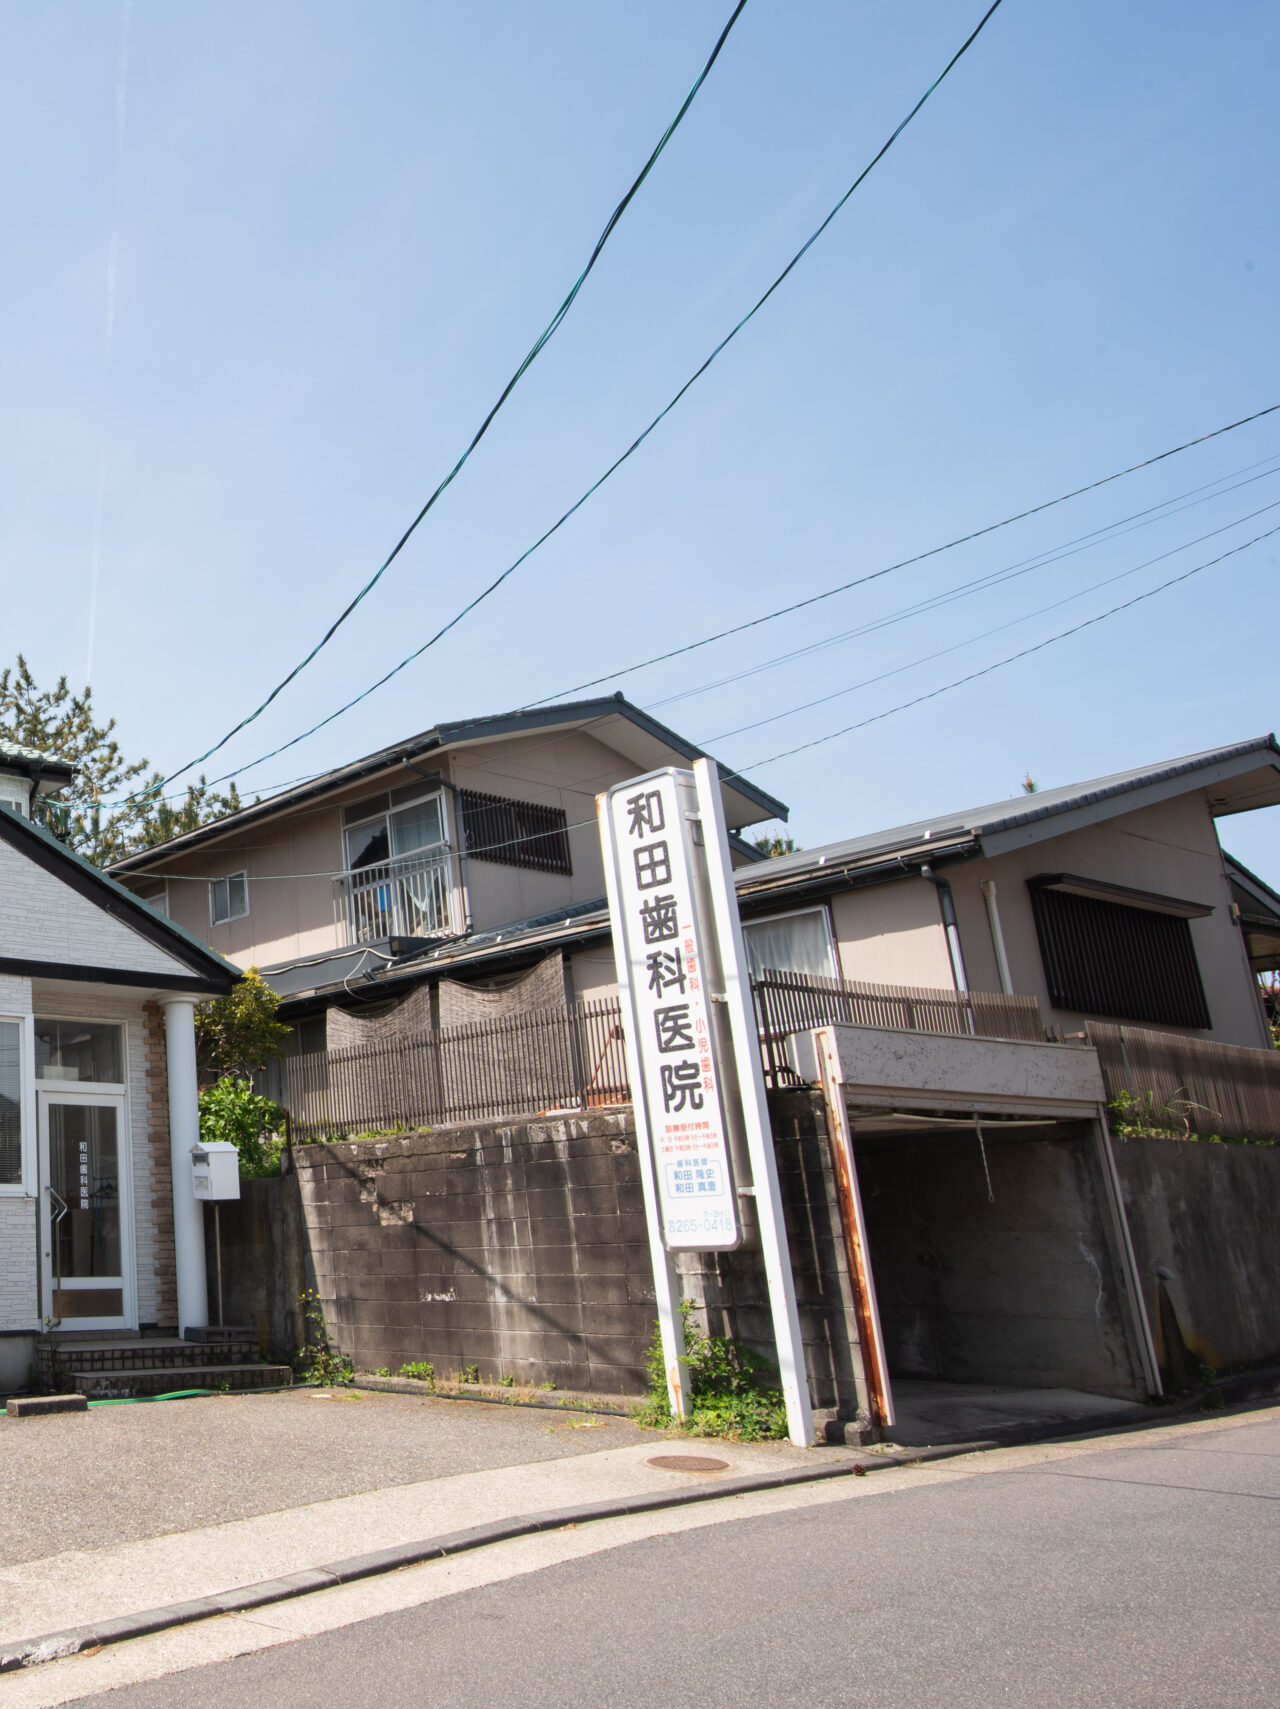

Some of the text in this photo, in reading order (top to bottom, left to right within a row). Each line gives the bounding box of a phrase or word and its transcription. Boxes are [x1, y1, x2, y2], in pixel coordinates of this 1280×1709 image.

[627, 790, 704, 1114] 和田歯科医院
[79, 1141, 89, 1210] 和田歯科医院
[674, 1170, 693, 1181] 和田
[675, 1182, 695, 1193] 和田
